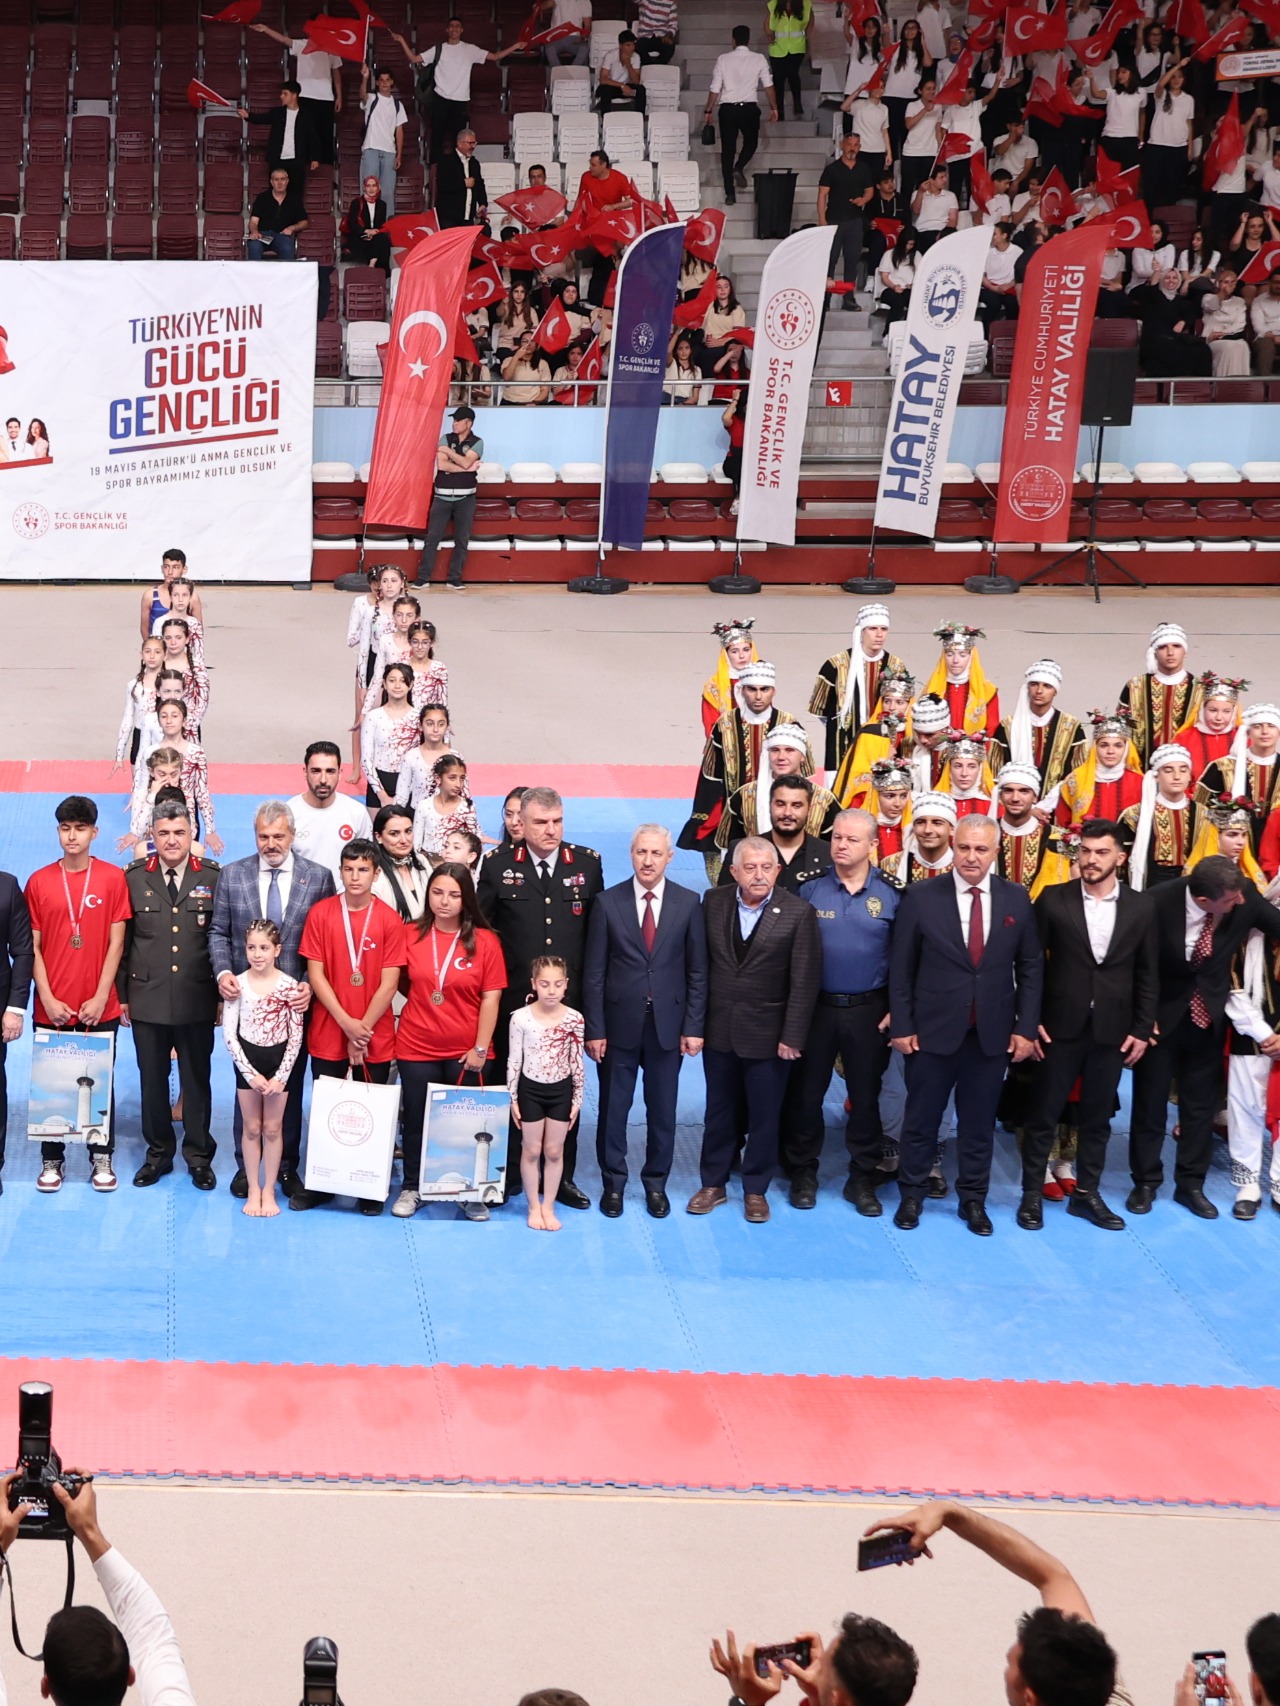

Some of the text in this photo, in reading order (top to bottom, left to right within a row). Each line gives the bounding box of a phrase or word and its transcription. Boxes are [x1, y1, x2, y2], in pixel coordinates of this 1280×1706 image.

[128, 303, 263, 344] TÜRKİYE'NİN
[144, 337, 247, 389] GÜCÜ
[1024, 265, 1059, 440] TÜRKİYE CUMHURİYETİ
[1044, 265, 1087, 442] HATAY VALİLİĞİ
[109, 378, 280, 440] GENÇLİĞİ
[756, 357, 780, 487] SPOR BAKANLIĞI
[769, 360, 794, 489] T.C. GENÇLİK VE
[882, 333, 941, 502] HATAY
[90, 466, 101, 476] 19
[105, 462, 137, 474] MAYIS
[200, 452, 230, 468] ANMA
[234, 444, 276, 459] GENÇLİK
[280, 443, 293, 453] VE
[106, 460, 277, 490] SPOR BAYRAMIMIZ KUTLU OLSUN!
[54, 511, 128, 521] T.C. GENÇLİK VE
[54, 521, 128, 530] SPOR BAKANLIĞI
[816, 909, 836, 919] OLİS
